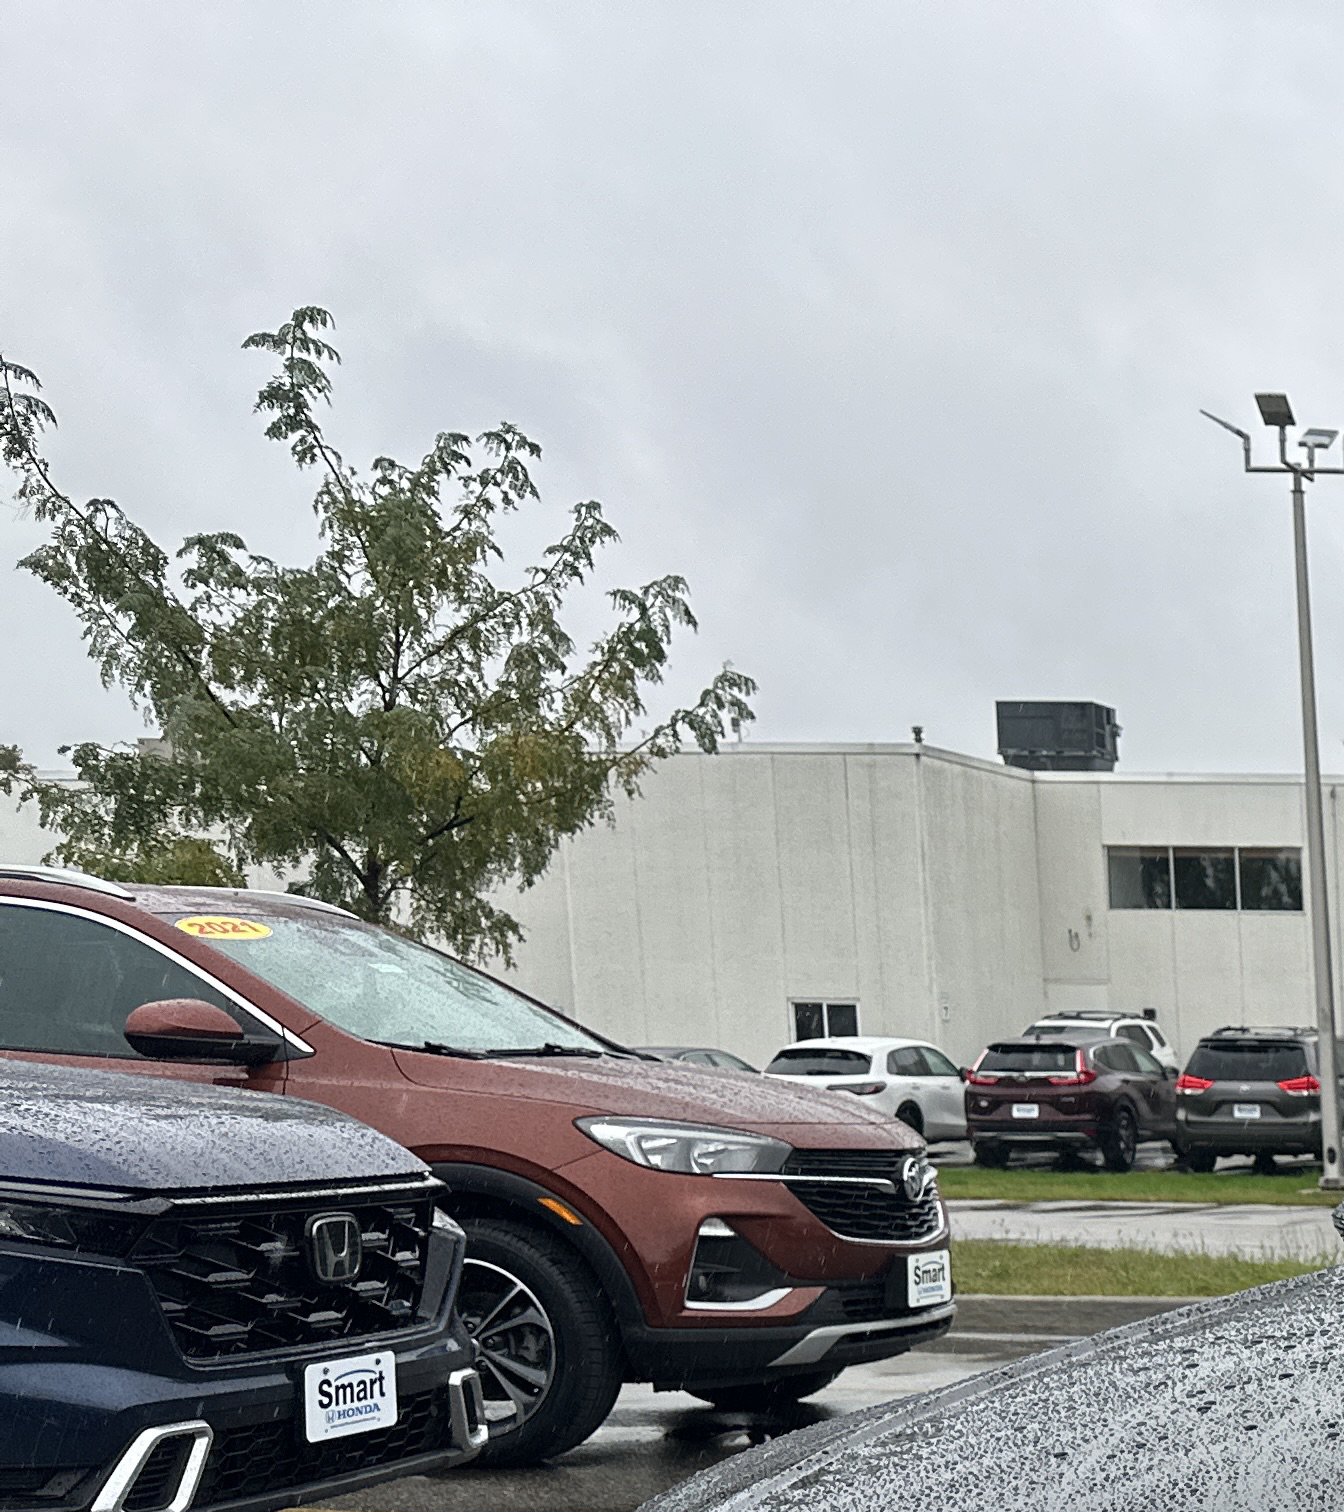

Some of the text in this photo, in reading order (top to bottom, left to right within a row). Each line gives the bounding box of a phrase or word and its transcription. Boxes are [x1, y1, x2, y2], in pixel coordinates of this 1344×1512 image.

[187, 921, 261, 935] 2021
[914, 1263, 946, 1286] Smart
[317, 1370, 386, 1409] Smart
[336, 1403, 381, 1420] HONDA
